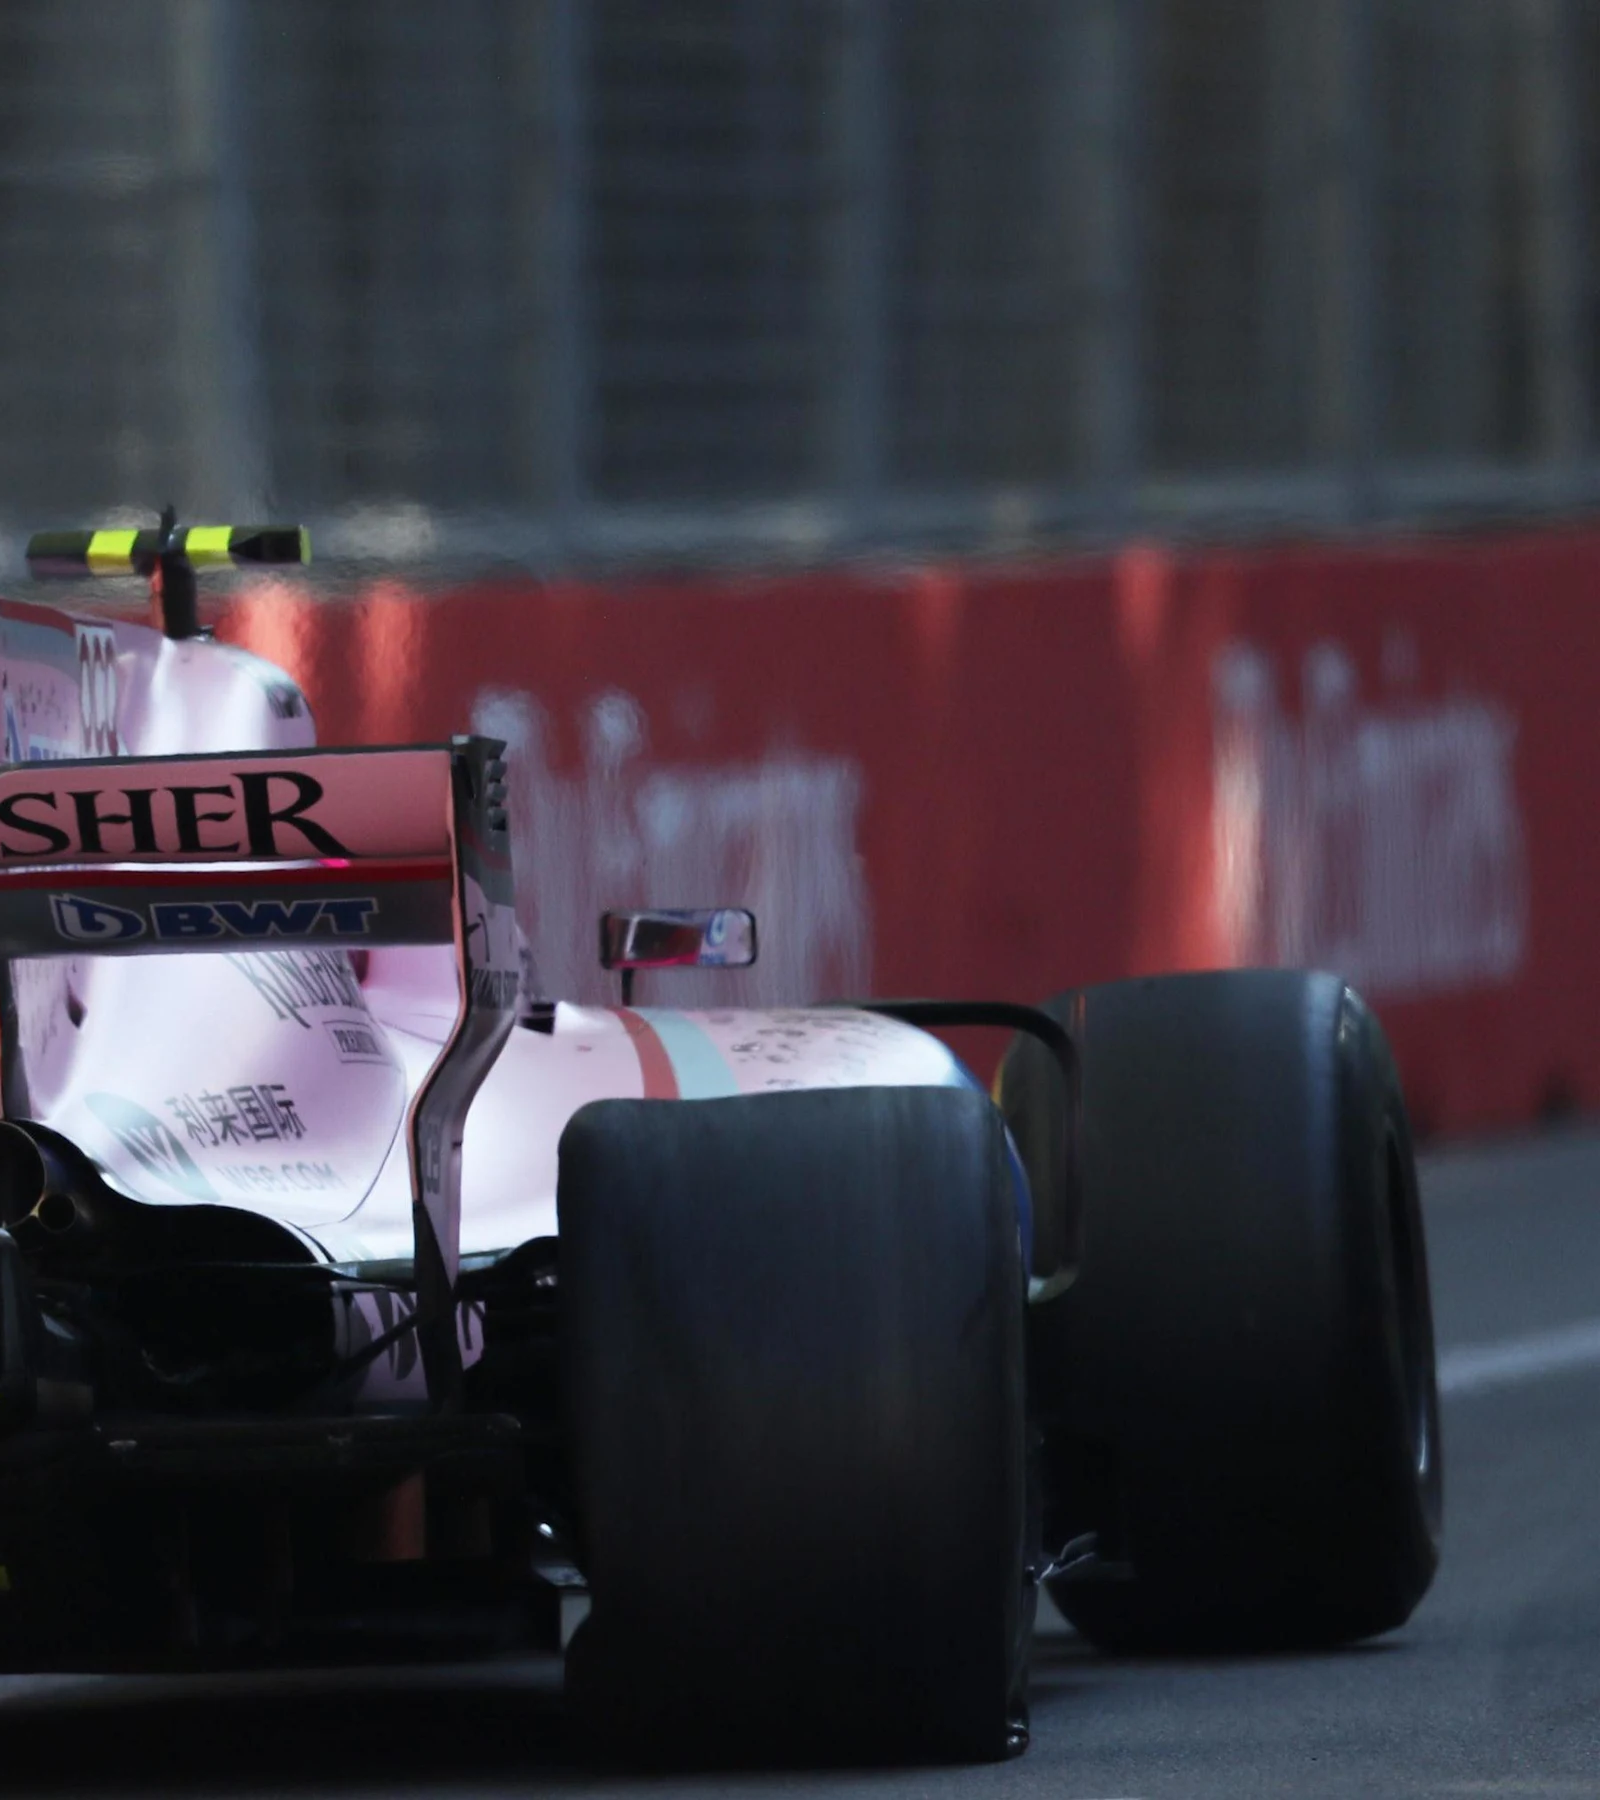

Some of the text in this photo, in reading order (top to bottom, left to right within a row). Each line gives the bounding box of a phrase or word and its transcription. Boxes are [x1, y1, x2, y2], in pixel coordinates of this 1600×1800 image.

[148, 896, 380, 942] BWT
[164, 1083, 308, 1149] 利来国际
